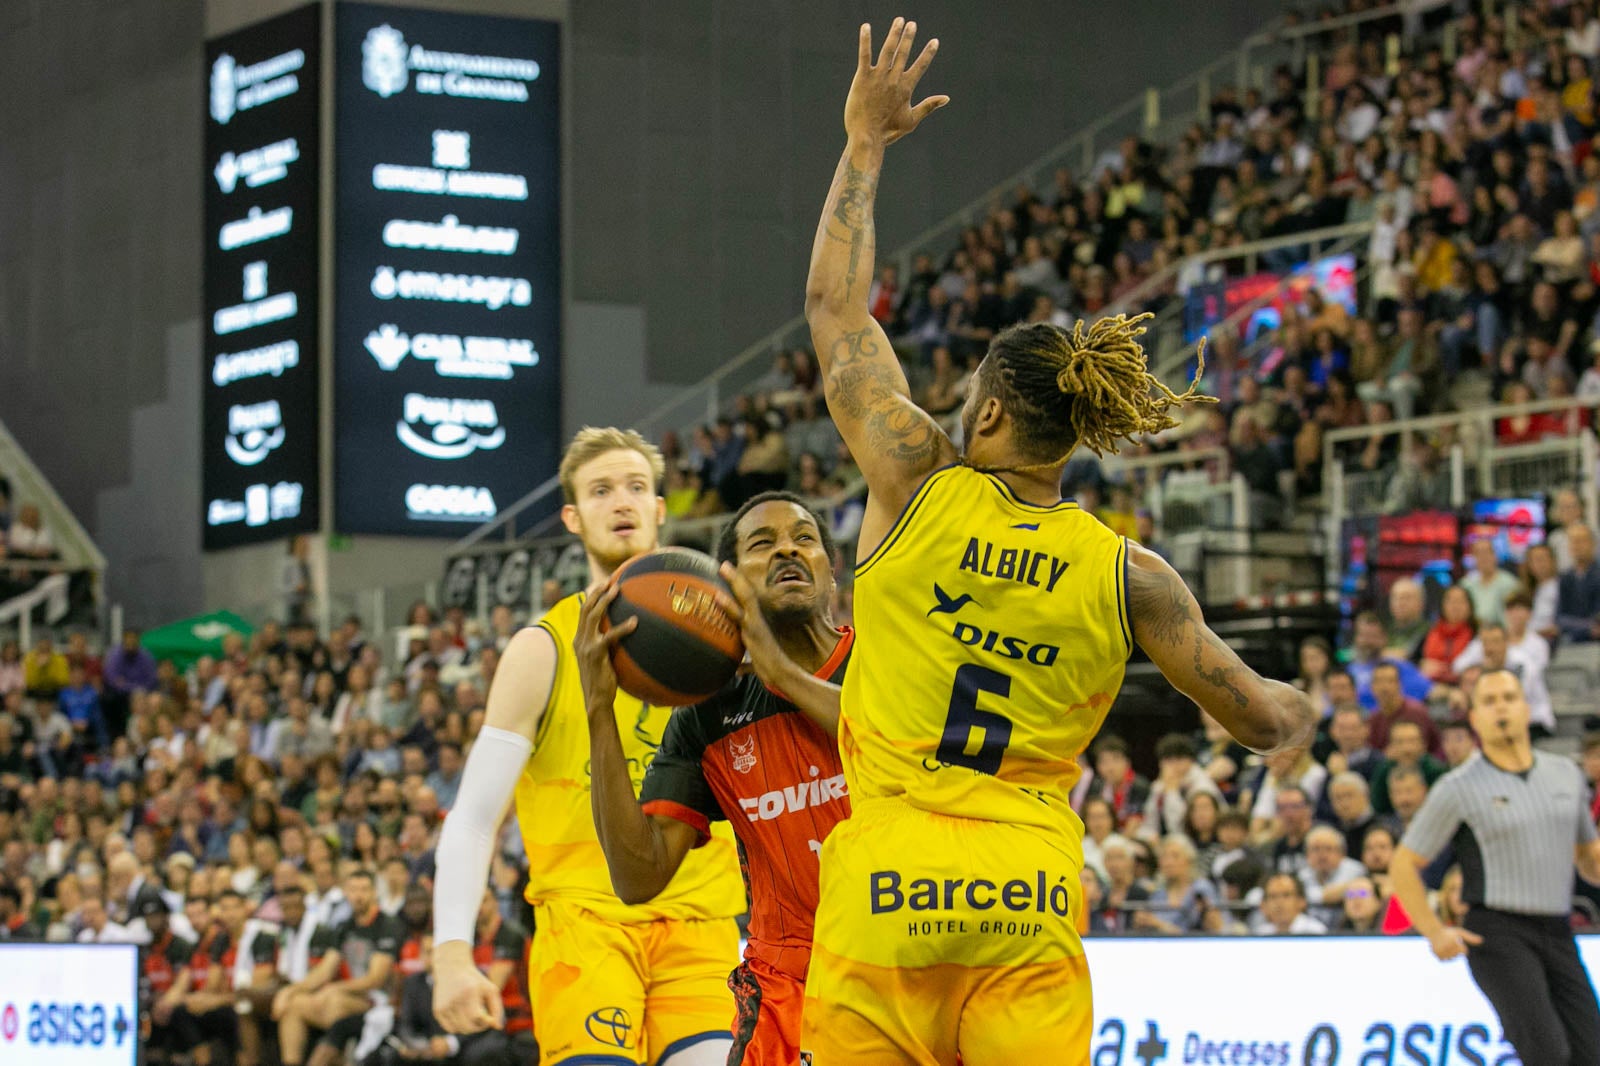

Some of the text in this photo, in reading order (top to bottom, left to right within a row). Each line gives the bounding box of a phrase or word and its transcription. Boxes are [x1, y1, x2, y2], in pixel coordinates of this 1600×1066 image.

[959, 537, 1070, 593] ALBICY
[935, 662, 1013, 777] 6
[870, 870, 1069, 917] Barceló
[908, 921, 1043, 937] HOTEL GROUP
[28, 1002, 107, 1045] asisa
[1183, 1031, 1291, 1066] Decesos
